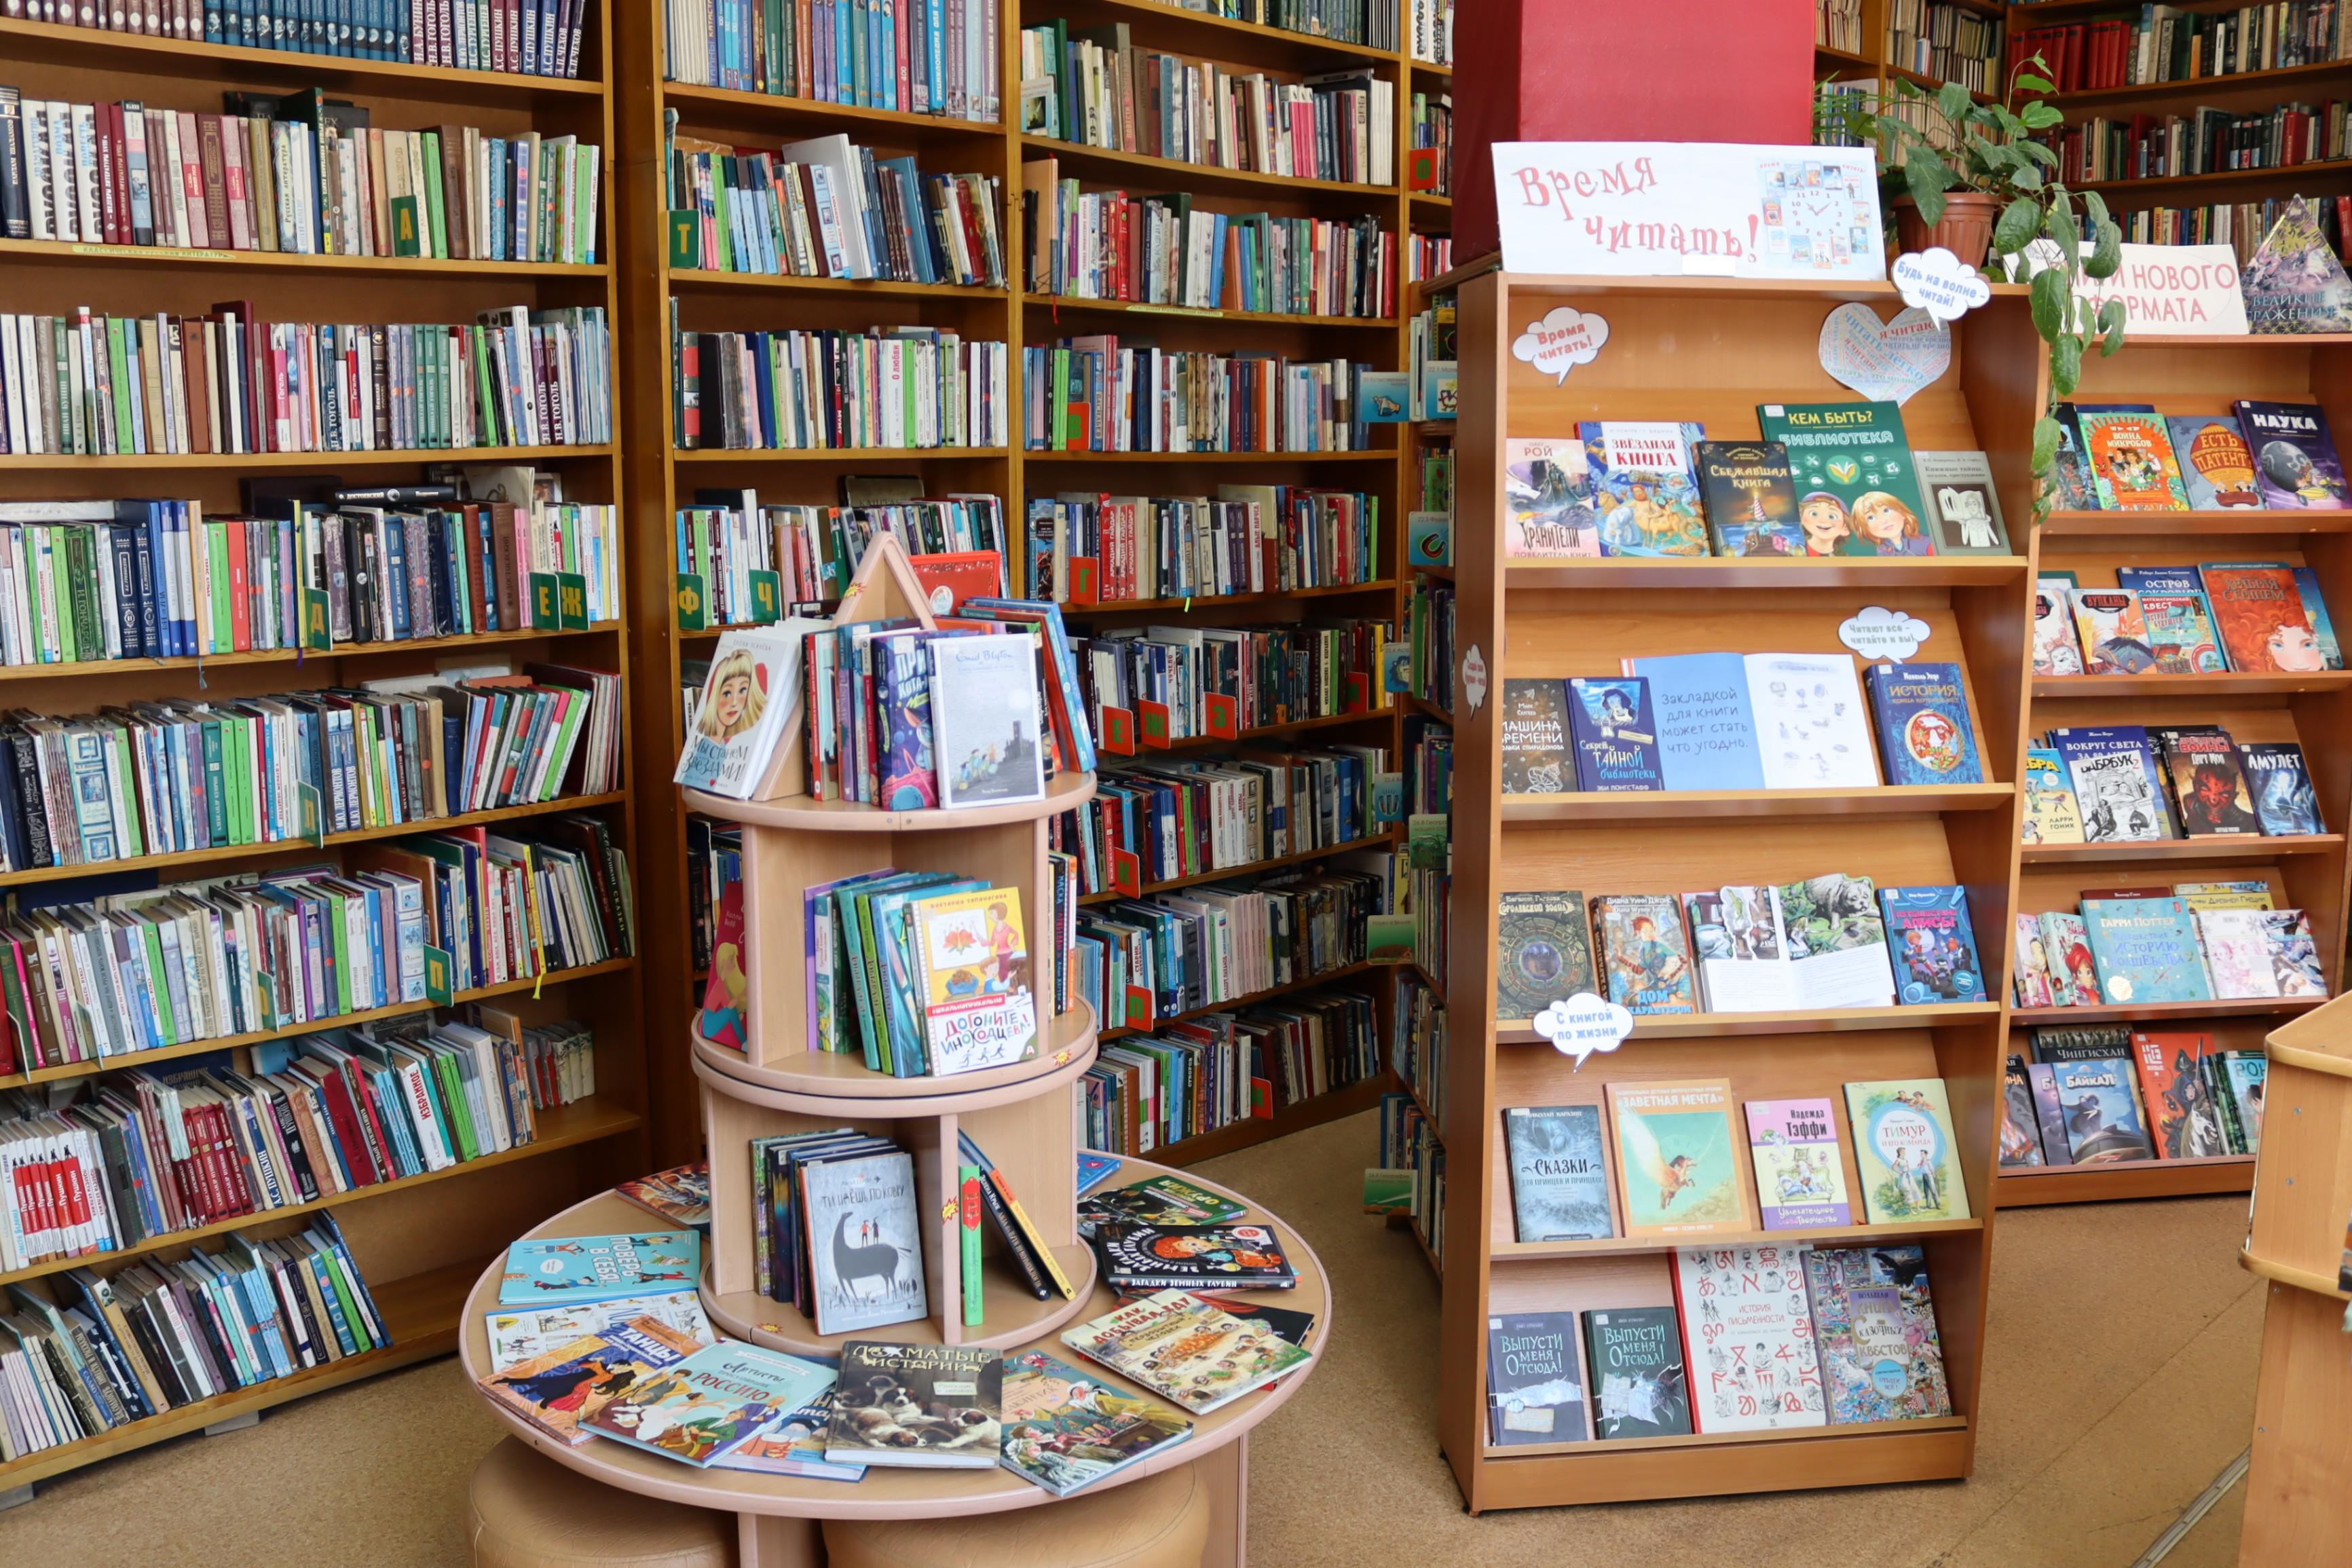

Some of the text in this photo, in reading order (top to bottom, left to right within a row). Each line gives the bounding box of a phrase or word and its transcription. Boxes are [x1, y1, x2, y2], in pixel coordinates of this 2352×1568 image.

[1511, 157, 1658, 221] Время
[400, 208, 413, 240] А
[677, 223, 690, 255] Т
[1583, 214, 1759, 263] читать!
[1897, 261, 1977, 299] Будь на волне
[2132, 263, 2236, 291] НОВОГО
[1920, 287, 1955, 307] читай!
[1537, 323, 1586, 345] Время
[1845, 312, 1884, 352] читать
[1539, 334, 1592, 360] читать!
[1068, 414, 1081, 439] В
[1789, 410, 1873, 425] КЕМ БЫТЬ?
[2252, 413, 2318, 431] НАУКА
[1612, 438, 1676, 450] ЗВЁЗДНАЯ
[1779, 430, 1894, 447] БИБЛИОТЕКА
[2106, 438, 2152, 449] МИКРОБОВ
[2200, 434, 2238, 449] ЕСТЬ
[1524, 446, 1552, 457] РОЙ
[1616, 452, 1677, 466] КНИГА
[1732, 478, 1771, 489] КНИГА
[1080, 568, 1091, 593] Г
[2145, 580, 2190, 589] ОСТРОВ
[538, 586, 550, 617] Е
[561, 586, 583, 618] Ж
[678, 586, 699, 615] Ф
[758, 582, 773, 611] Ч
[2087, 595, 2127, 608] ВУЛКАНЫ
[2143, 601, 2172, 610] КВЕСТ
[310, 603, 326, 635] Д
[1849, 623, 1884, 634] Читают
[1850, 635, 1886, 645] читайте
[1661, 686, 1738, 705] Закладкой
[1213, 706, 1226, 728] З
[1666, 705, 1739, 724] для книги
[1113, 720, 1123, 745] Е
[1145, 713, 1165, 739] Ж
[1662, 722, 1748, 739] может стать
[1666, 737, 1749, 758] что угодно.
[2066, 740, 2143, 752] ВОКРУГ СВЕТА
[1593, 745, 1643, 768] ТАЙНОЙ
[2132, 758, 2140, 770] 2
[2248, 754, 2300, 770] АМУЛЕТ
[1601, 768, 1656, 779] библиотеки
[2049, 816, 2074, 824] ЛАРРИ
[2049, 822, 2075, 830] ГОНИК
[1903, 916, 1955, 929] АЛИСЫ
[2099, 916, 2177, 929] ГАРРИ ПОТТЕР
[1639, 990, 1669, 1003] ДОМ
[945, 1009, 1018, 1041] ДОГОНИТЕ
[1556, 1009, 1613, 1024] С книгой
[1558, 1027, 1618, 1040] по жизни
[2057, 1048, 2125, 1060] ЧИНГИСХАН
[2065, 1074, 2115, 1087] БАЙКАЛ
[409, 1069, 431, 1120] ИЗБРАННОЕ
[1791, 1109, 1825, 1119] Надежда
[1786, 1121, 1827, 1139] Тэффи
[1882, 1125, 1926, 1138] ТИМУР
[35, 1182, 45, 1208] Пушкин
[44, 1180, 54, 1208] Пушкин
[56, 1173, 67, 1207] Пушкин
[70, 1170, 82, 1202] Пушкин
[869, 1188, 882, 1200] ПО
[17, 1186, 26, 1212] Пушкин
[25, 1184, 35, 1210] Пушкин
[610, 1237, 641, 1277] ПОВЕРЬ
[1132, 1278, 1237, 1288] ЗАГАДКИ ЗЕМНЫХ ГЛУБИН
[1698, 1275, 1716, 1296] あ
[1161, 1296, 1192, 1314] ЕДУ
[1739, 1303, 1772, 1313] ИСТОРИЯ
[1114, 1307, 1143, 1322] КАК
[1728, 1314, 1785, 1326] ПИСЬМЕННОСТИ
[619, 1327, 682, 1362] ТАНЦЫ
[1623, 1341, 1656, 1354] МЕНЯ
[1520, 1350, 1554, 1362] МЕНЯ
[691, 1373, 770, 1401] РОССИЮ
